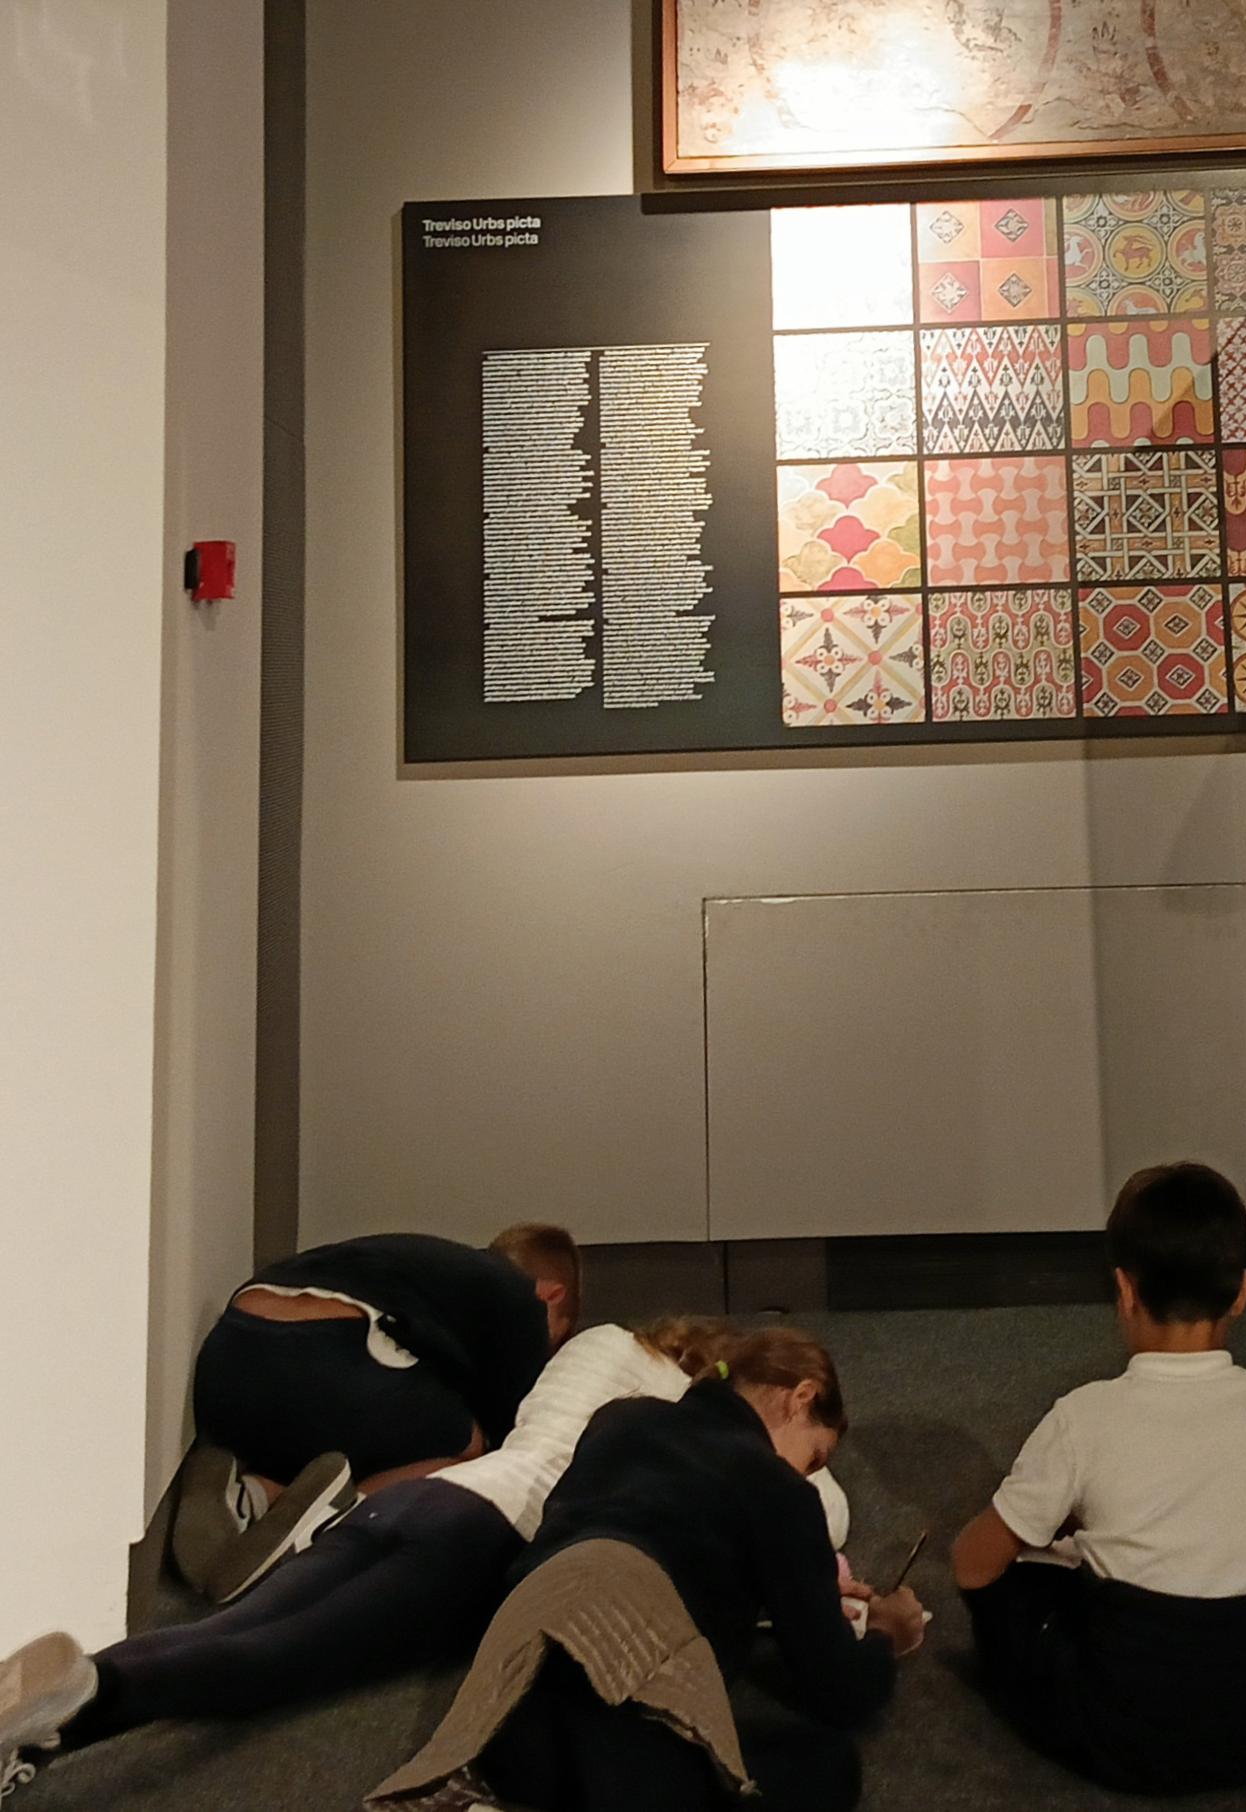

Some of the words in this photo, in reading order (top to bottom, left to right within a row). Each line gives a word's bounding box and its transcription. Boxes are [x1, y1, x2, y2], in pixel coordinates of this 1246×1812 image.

[422, 218, 472, 232] Treviso
[472, 216, 505, 230] Urbs
[506, 215, 541, 231] picta
[422, 234, 470, 248] Treviso
[471, 233, 503, 247] Urbs
[504, 232, 539, 248] picta
